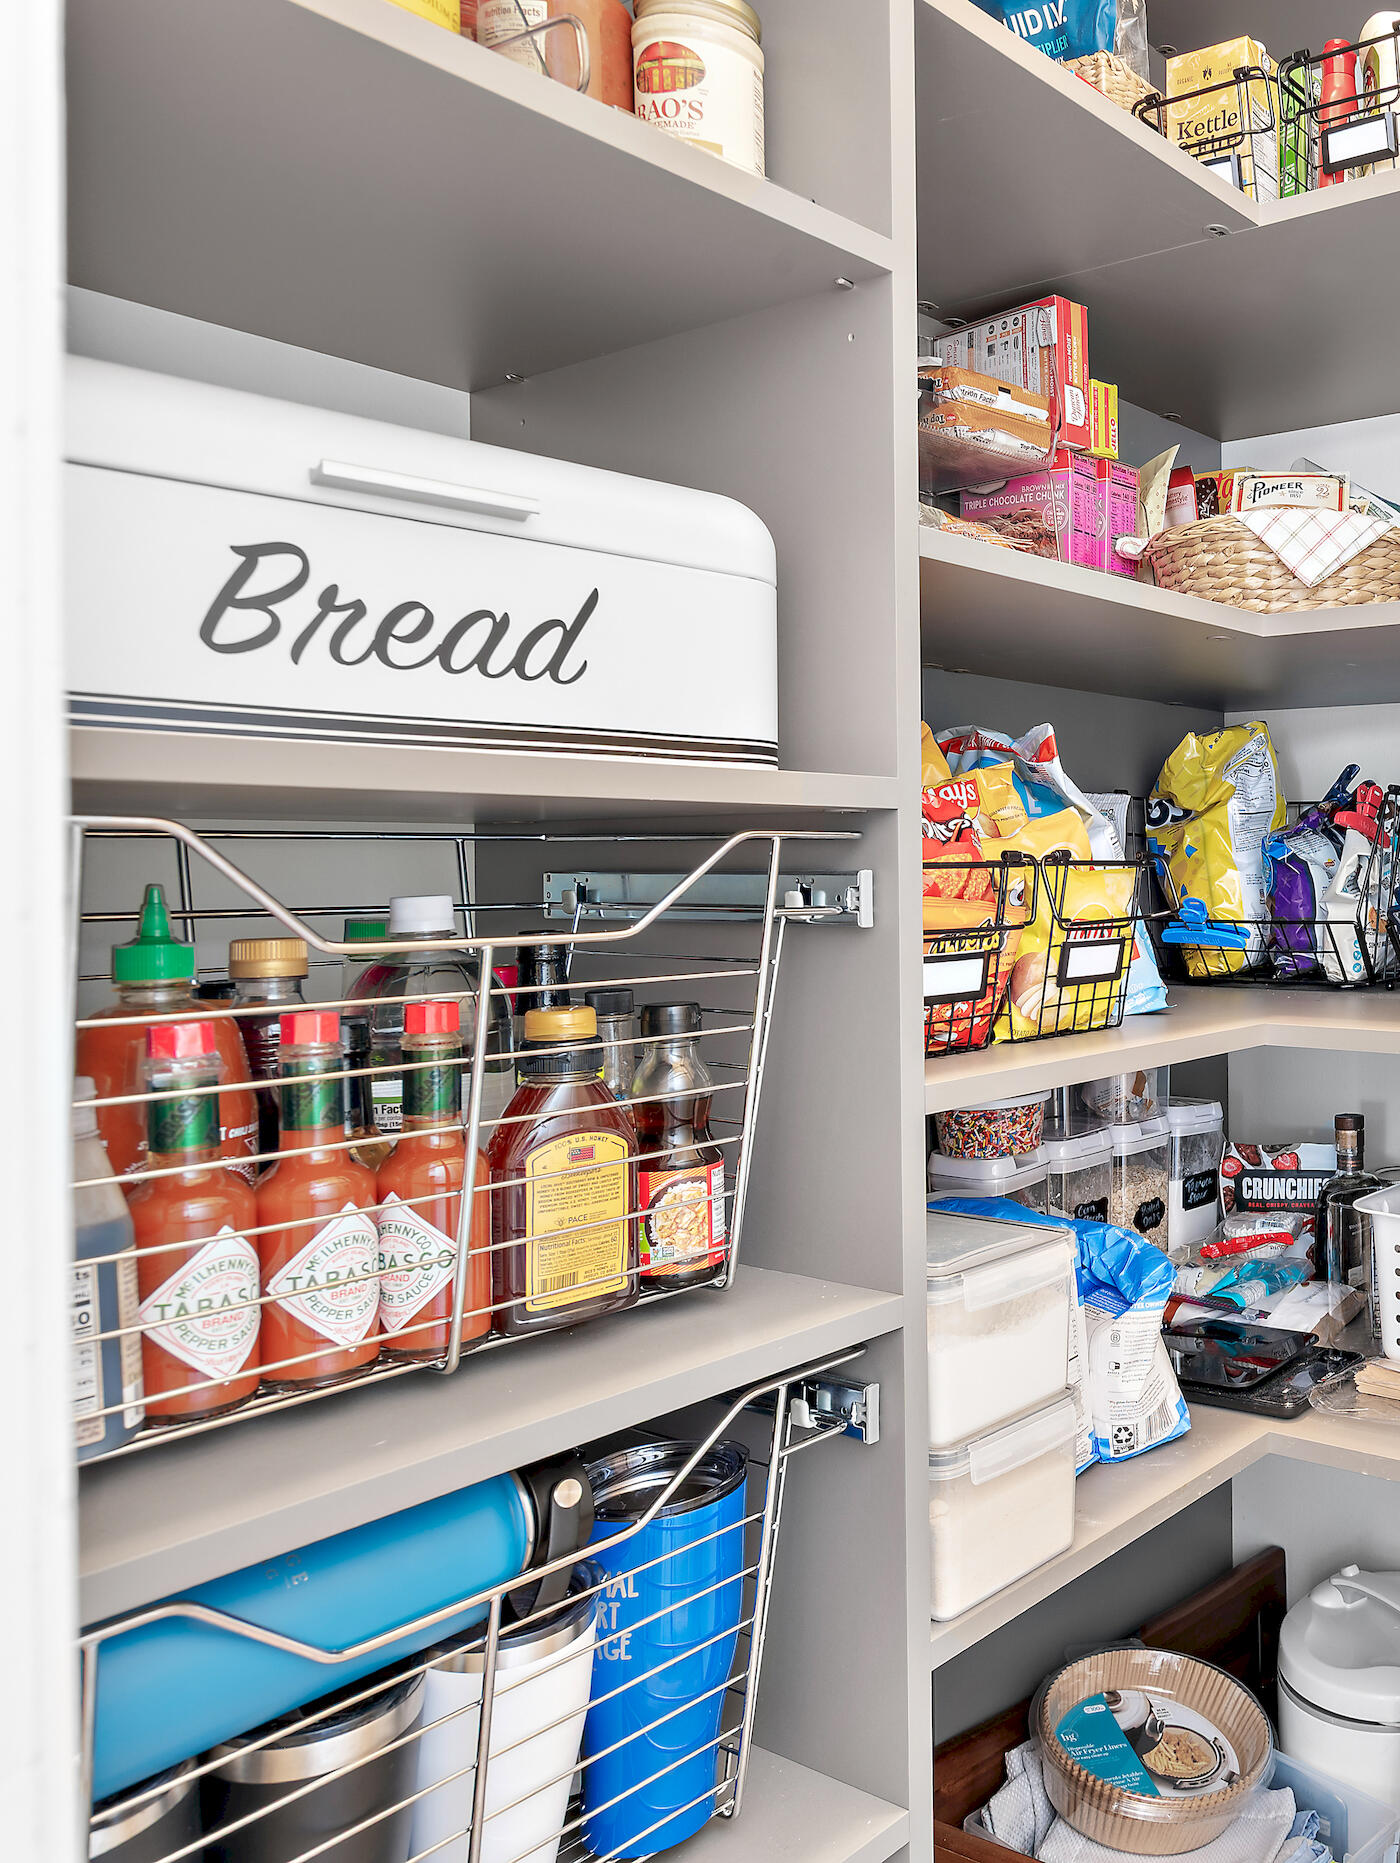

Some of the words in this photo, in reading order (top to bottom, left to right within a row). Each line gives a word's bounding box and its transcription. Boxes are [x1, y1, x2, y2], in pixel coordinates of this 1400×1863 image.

[1002, 8, 1044, 38] UID
[1039, 33, 1069, 56] TIPLIER
[655, 120, 696, 129] EMADE
[1176, 108, 1238, 141] Kettle
[964, 501, 987, 511] TRIPLE
[988, 493, 1034, 507] CHOCOLATE
[1252, 481, 1304, 504] PIONEER
[199, 540, 599, 685] Bread
[589, 1134, 609, 1142] HONEY
[1241, 1176, 1331, 1200] CRUNCHIE
[567, 1213, 589, 1224] PACE
[539, 1238, 571, 1251] Nutritional
[571, 1237, 586, 1245] Facts
[378, 1249, 453, 1272] BASCO
[286, 1257, 378, 1292] TABASC
[330, 1283, 368, 1301] BRAND
[396, 1272, 434, 1305] SAUCE
[153, 1283, 258, 1321] TABASC
[305, 1293, 353, 1321] PEPPER
[202, 1311, 244, 1330] BRAND
[175, 1323, 227, 1351] PEPPER
[595, 1601, 621, 1630] RT
[595, 1632, 633, 1661] AGE
[1060, 1732, 1078, 1743] hg
[1070, 1749, 1082, 1757] Air
[1083, 1747, 1104, 1756] Fryer
[1104, 1743, 1128, 1752] Liners
